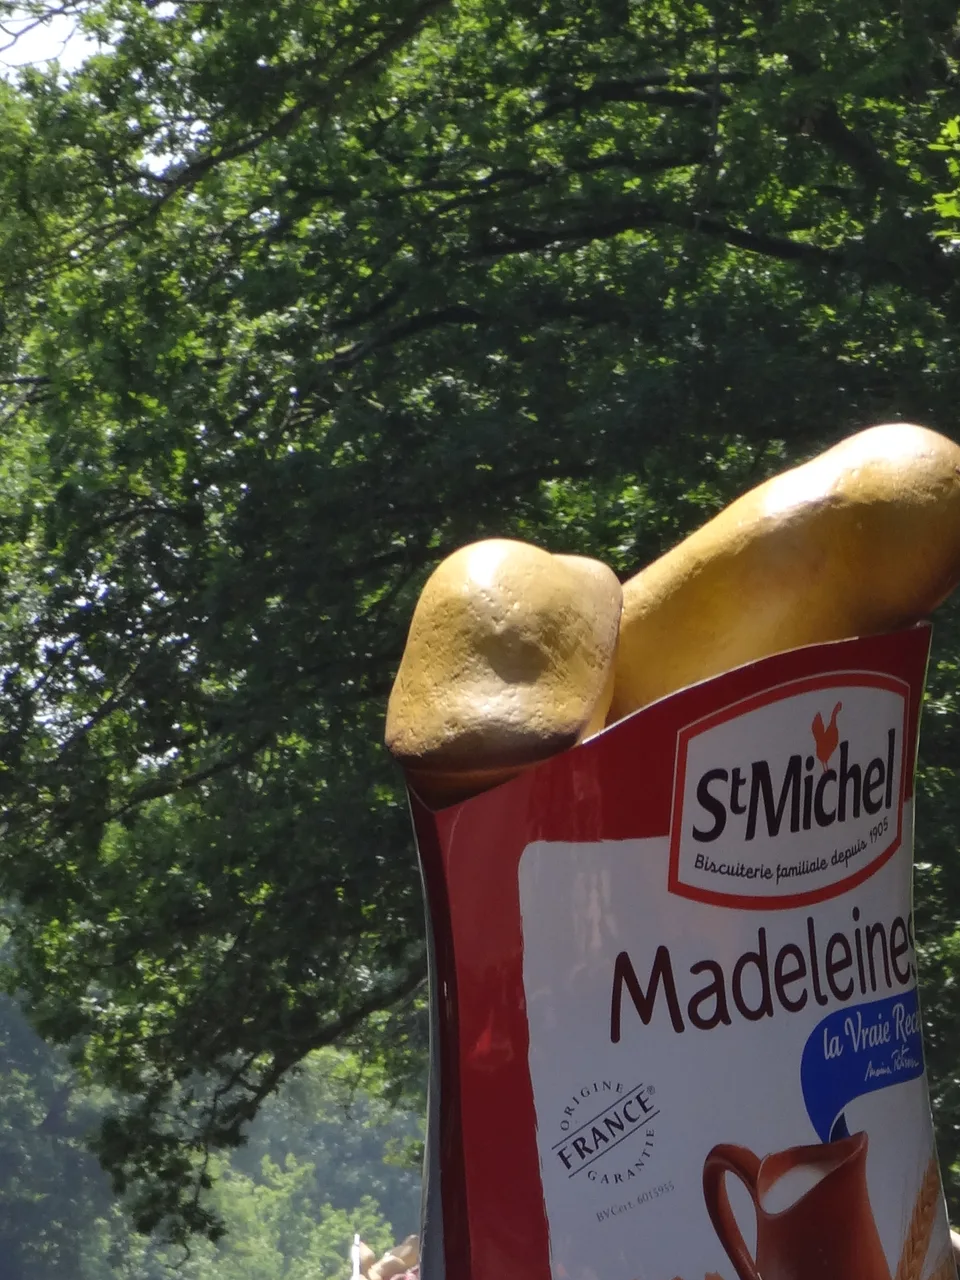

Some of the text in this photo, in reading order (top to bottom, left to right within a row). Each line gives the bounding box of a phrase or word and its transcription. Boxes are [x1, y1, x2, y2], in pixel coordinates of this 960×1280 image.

[694, 816, 890, 886] Biscuiterie familiale depuis 1905
[823, 1027, 844, 1060] la
[844, 1011, 892, 1053] Vraie
[559, 1079, 625, 1132] ORIGINE
[587, 1127, 655, 1186] GARANTIE
